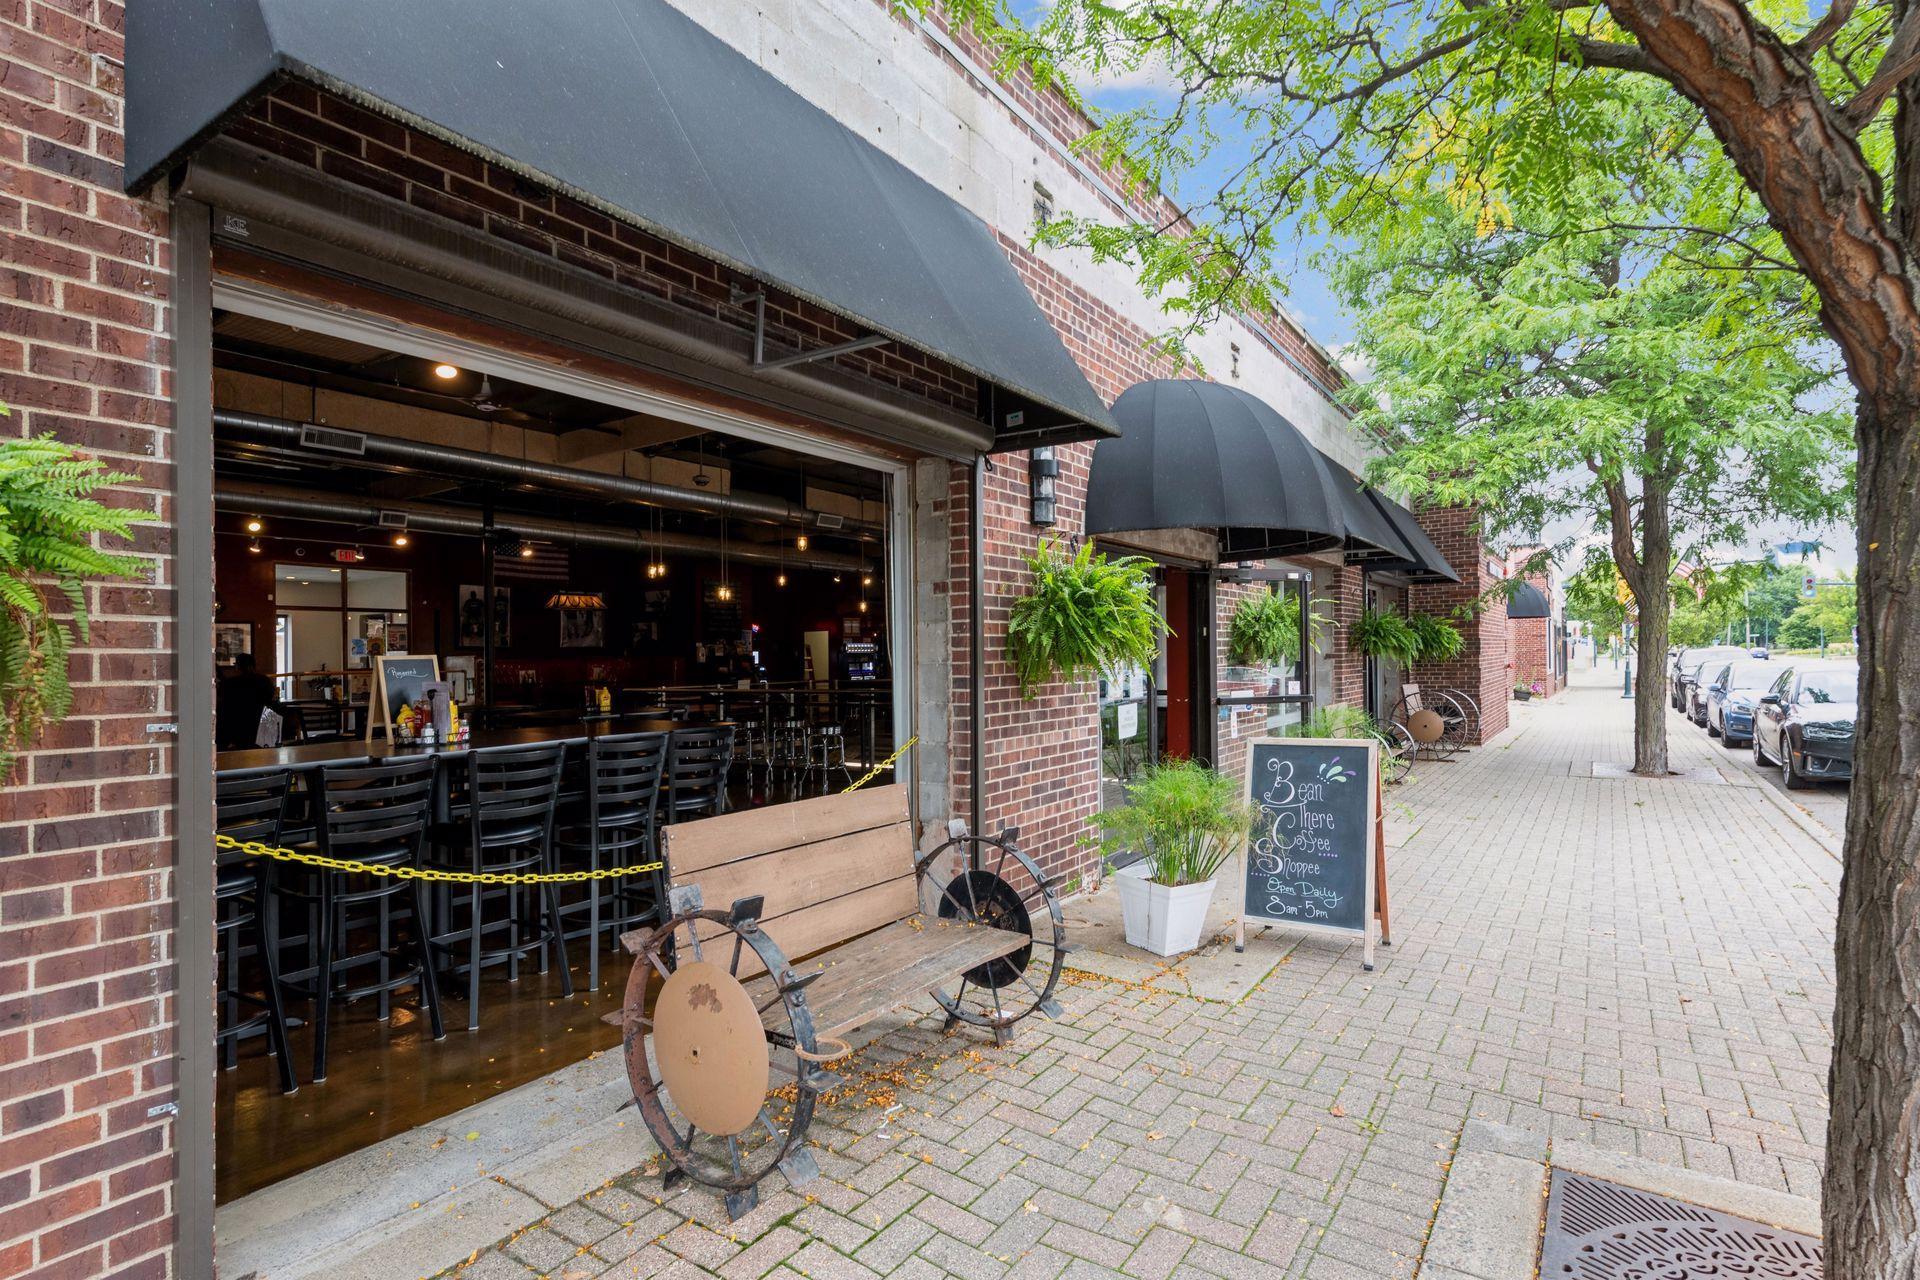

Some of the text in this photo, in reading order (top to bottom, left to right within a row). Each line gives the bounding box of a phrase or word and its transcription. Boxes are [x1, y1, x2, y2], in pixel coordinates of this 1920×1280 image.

[1263, 758, 1324, 805] Bean
[1260, 800, 1335, 830] There
[1272, 812, 1331, 853] Coffee
[1255, 837, 1320, 879] Shoppee
[1267, 877, 1343, 908] Open Daily
